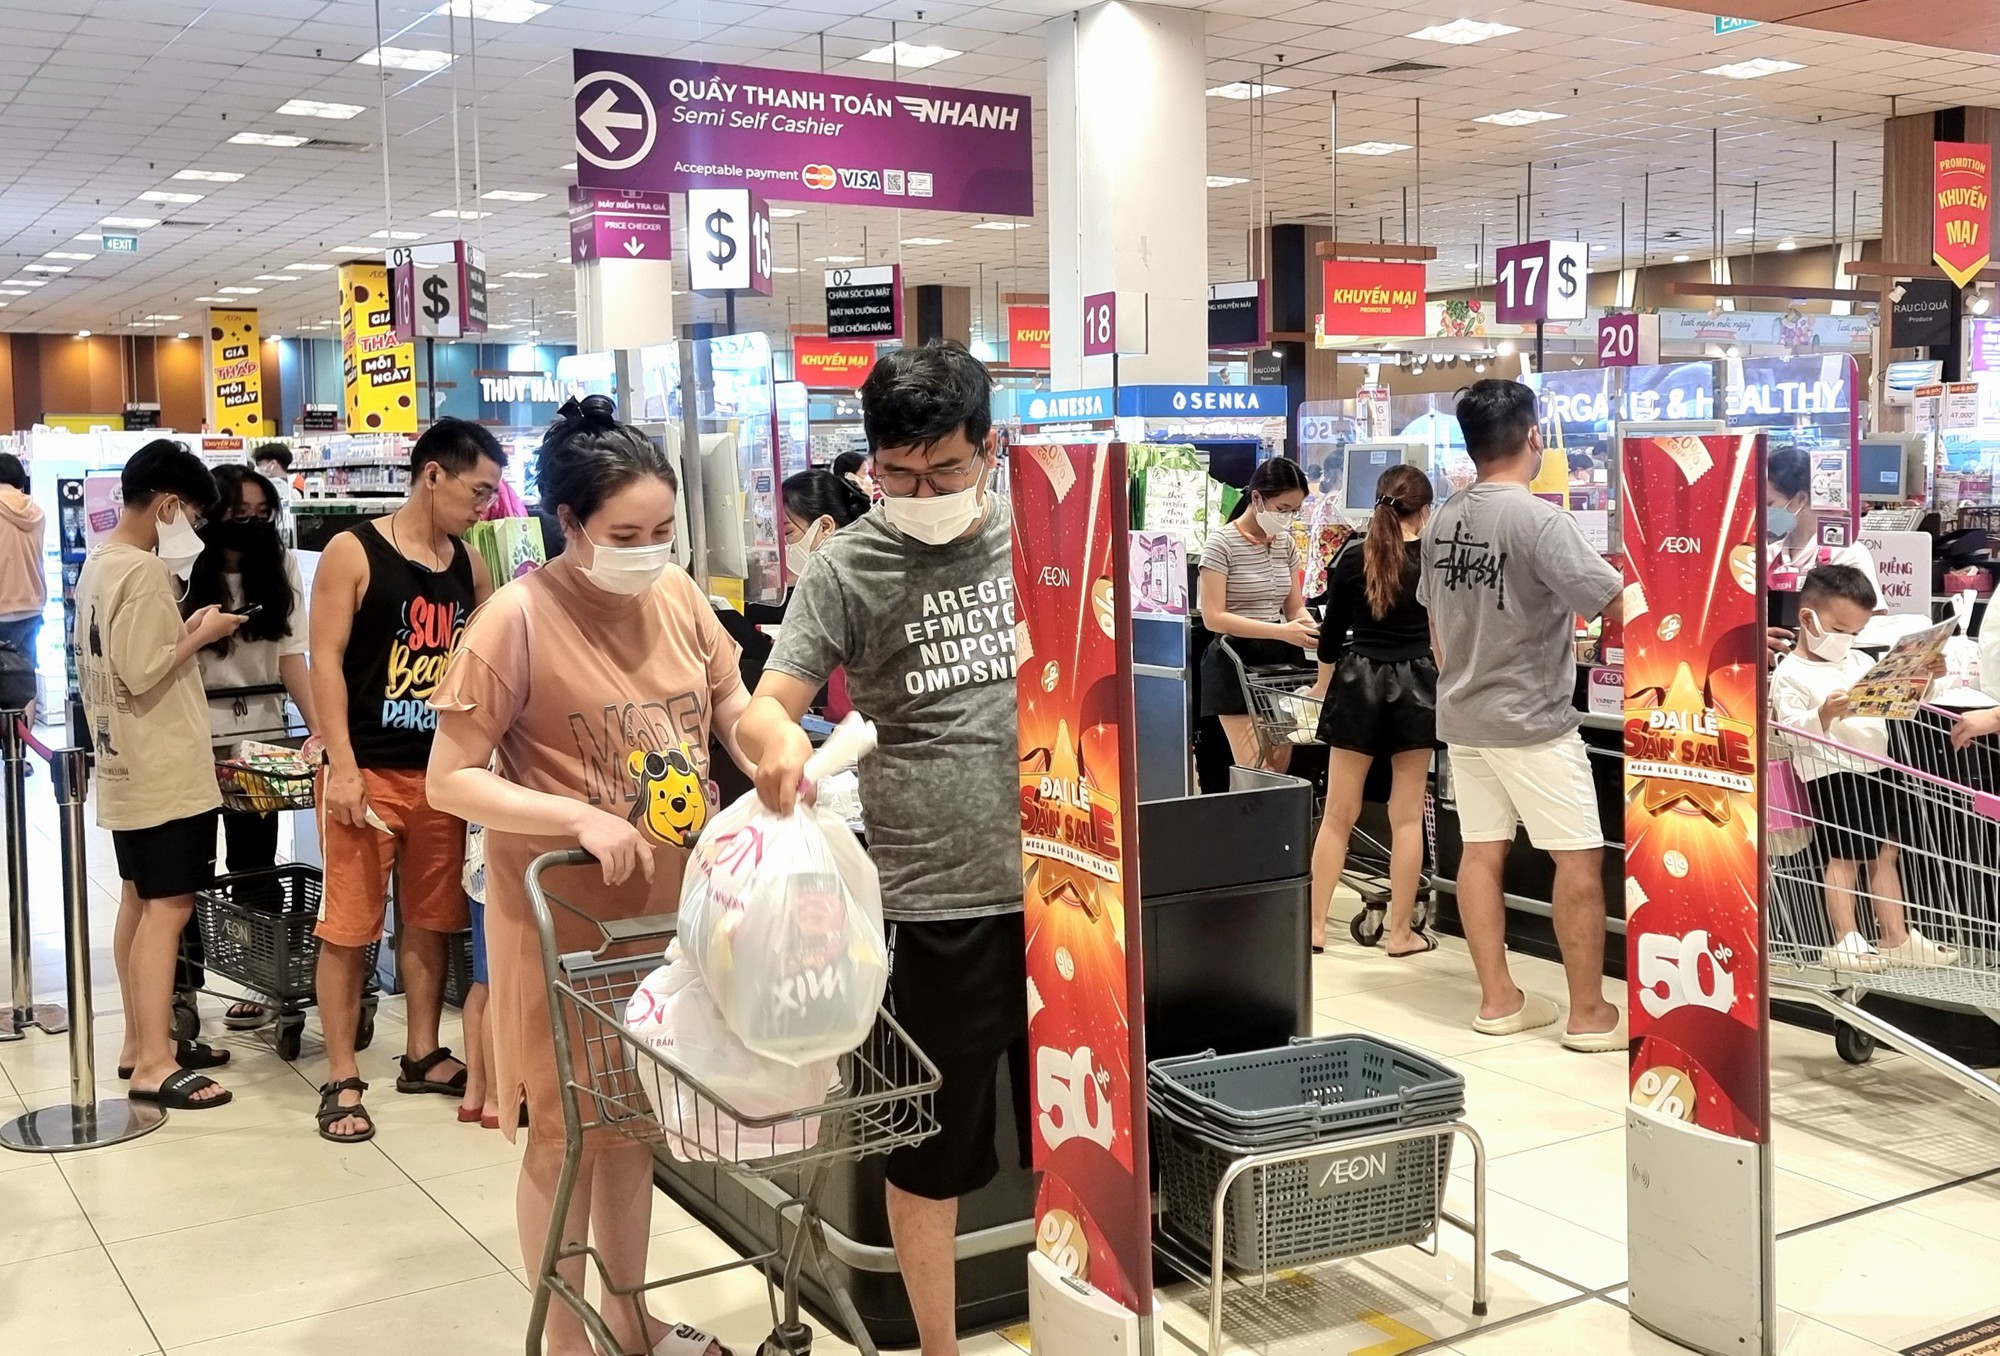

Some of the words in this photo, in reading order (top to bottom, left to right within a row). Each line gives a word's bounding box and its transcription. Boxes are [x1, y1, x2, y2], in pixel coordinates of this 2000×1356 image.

[1721, 16, 1747, 29] EX
[669, 75, 738, 102] QUẦY
[743, 85, 825, 112] THANH
[830, 93, 892, 118] TOÁN
[919, 98, 1020, 132] NHANH
[672, 106, 726, 126] Semi
[729, 111, 769, 130] Self
[771, 114, 844, 136] Cashier
[674, 161, 743, 177] Acceptable
[746, 168, 799, 181] payment
[842, 170, 881, 189] VISA
[1939, 157, 1987, 174] PROMOTION
[636, 202, 651, 210] TRA
[1938, 185, 1988, 211] KHUYẾN
[604, 221, 627, 231] PRICE
[628, 223, 662, 232] CHECKER
[1945, 220, 1979, 248] MẠI
[113, 239, 133, 250] EXIT
[752, 211, 771, 280] 15
[833, 269, 852, 286] 02
[1500, 256, 1544, 308] 17
[396, 277, 410, 325] 16
[865, 289, 875, 297] DA
[1333, 285, 1390, 305] KHUYẾN
[1392, 290, 1417, 309] MẠI
[1893, 304, 1913, 313] RAU
[1913, 301, 1927, 312] CỦ
[830, 325, 844, 334] KEM
[1017, 329, 1050, 342] KHUY
[1086, 304, 1111, 345] 18
[225, 345, 245, 359] GIÁ
[359, 330, 404, 353] THẤ
[1601, 323, 1634, 358] 20
[215, 360, 258, 380] THẤP
[365, 355, 392, 373] MỖI
[801, 352, 847, 366] KHUYẾN
[848, 355, 869, 369] MẠI
[373, 368, 410, 385] NGÀY
[220, 382, 242, 396] MỖI
[226, 392, 257, 406] NGÀY
[1191, 391, 1260, 410] SENKA
[1048, 395, 1104, 418] ANESSA
[1667, 388, 1689, 421] &
[409, 596, 454, 651] SUN
[919, 628, 1016, 667] NDPCH
[385, 627, 464, 699] Bea
[1650, 709, 1688, 735] ĐẠI
[1692, 706, 1720, 737] LỄ
[1681, 728, 1756, 775] SALE
[1631, 763, 1653, 772] MEGA
[1657, 765, 1679, 775] SALE
[1040, 776, 1069, 807] ĐẠI
[1070, 775, 1091, 812] LỄ
[1065, 803, 1121, 861] SALE
[1025, 840, 1045, 850] MEGA
[1048, 844, 1064, 855] SALE
